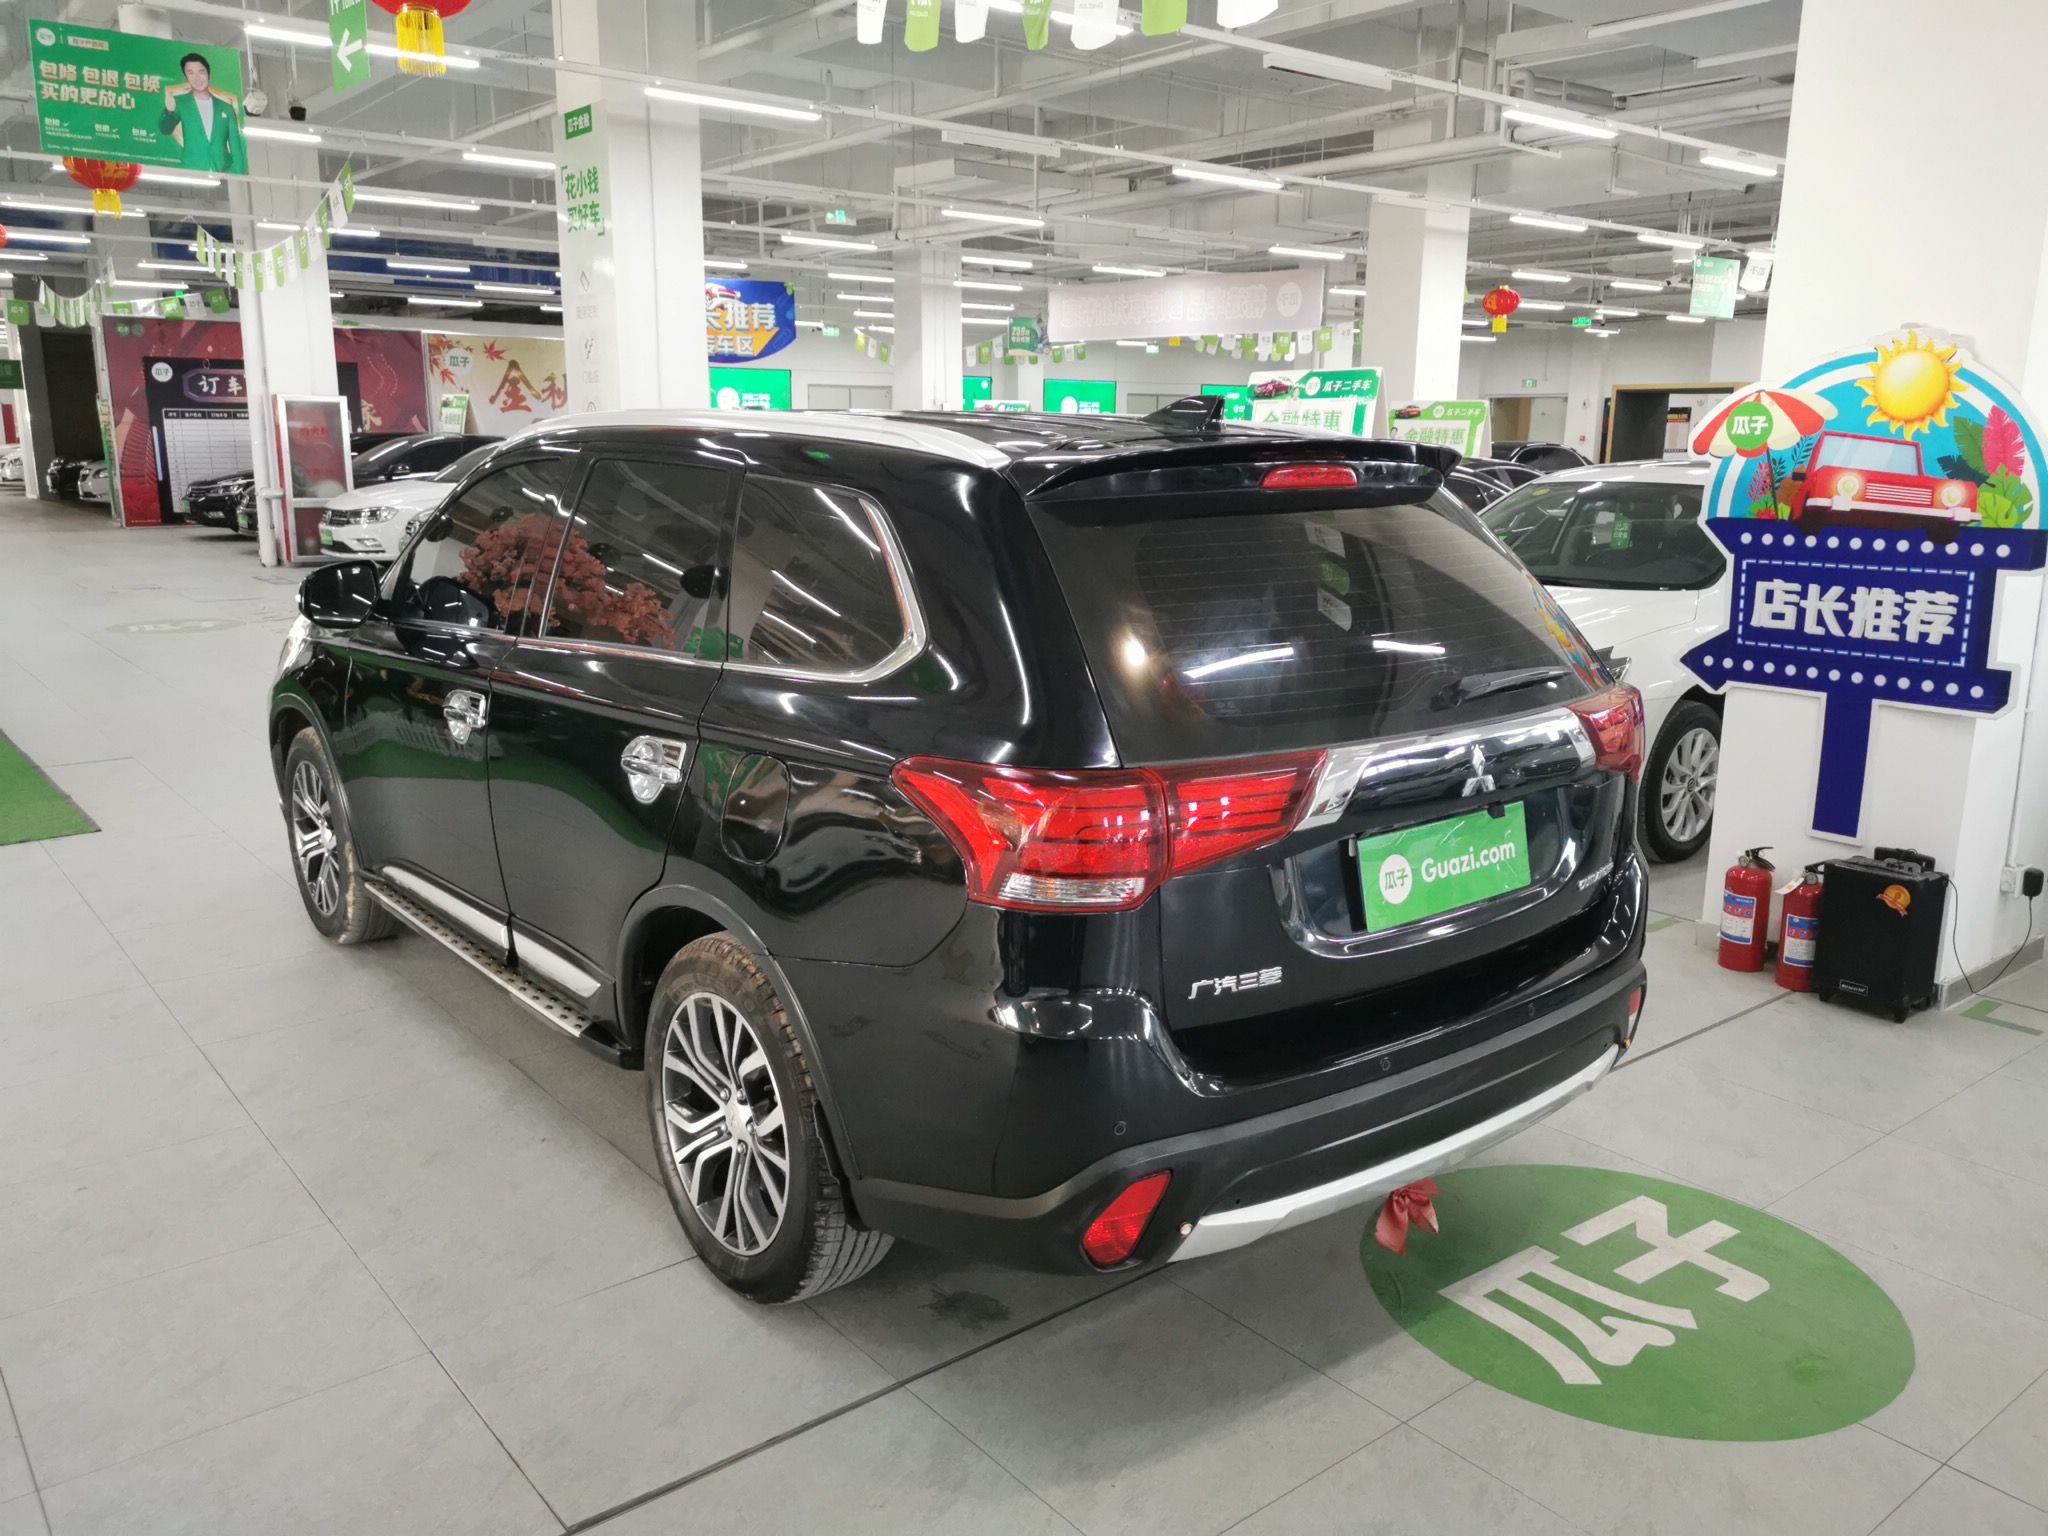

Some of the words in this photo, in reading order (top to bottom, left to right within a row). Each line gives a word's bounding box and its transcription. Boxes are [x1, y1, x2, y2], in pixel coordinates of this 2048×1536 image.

[82, 66, 119, 88] 包退
[124, 72, 161, 93] 包换
[38, 81, 136, 110] 买的更放心
[155, 369, 169, 377] 瓜子
[449, 356, 470, 368] 瓜子
[1322, 379, 1373, 393] 瓜子二手车
[1730, 414, 1770, 437] 瓜子
[1750, 578, 1960, 646] 店长推荐
[1421, 841, 1516, 883] Guazi.com
[1384, 867, 1409, 891] 瓜子
[1187, 966, 1283, 1000] 广汽三菱
[1436, 1194, 1771, 1386] 瓜子
